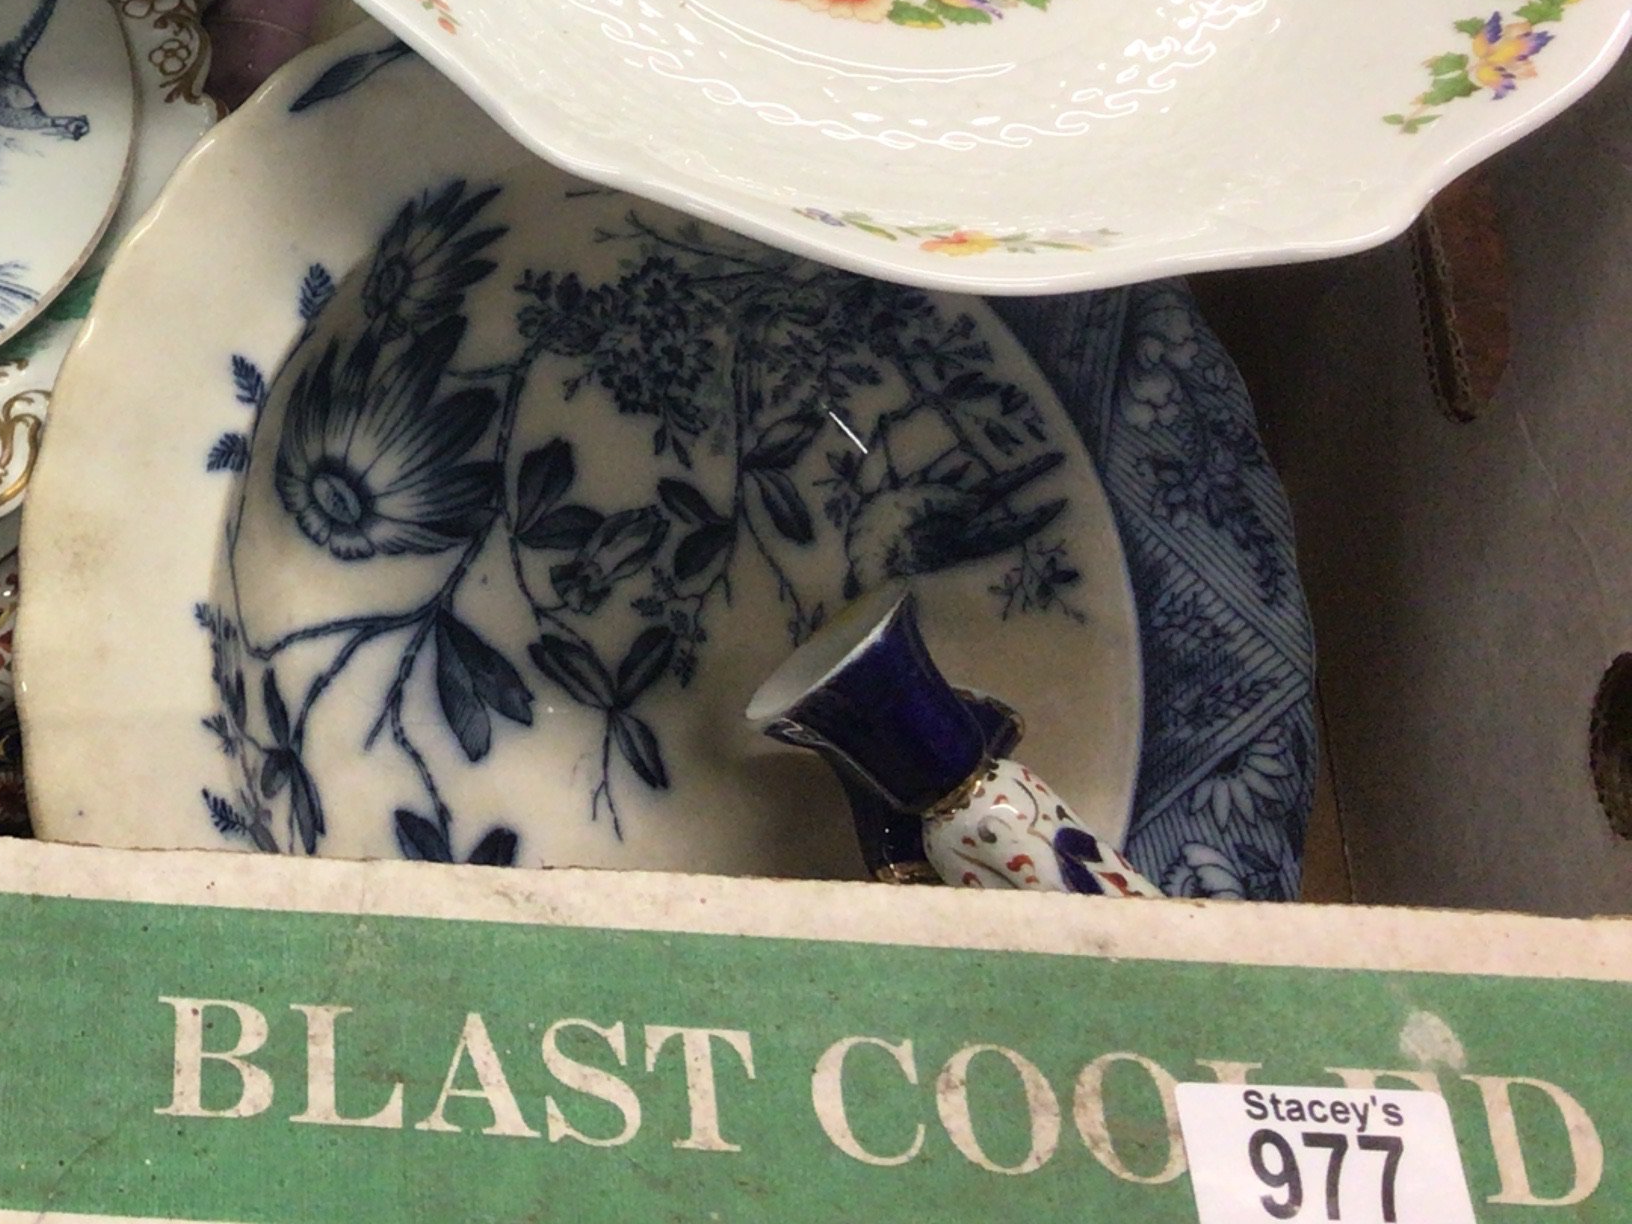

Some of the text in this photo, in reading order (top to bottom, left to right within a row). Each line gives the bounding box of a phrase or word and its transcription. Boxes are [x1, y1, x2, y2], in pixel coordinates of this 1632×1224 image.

[154, 995, 1604, 1206] BLAST COOD
[1243, 1089, 1404, 1133] Stacey's
[1248, 1128, 1404, 1223] 977
